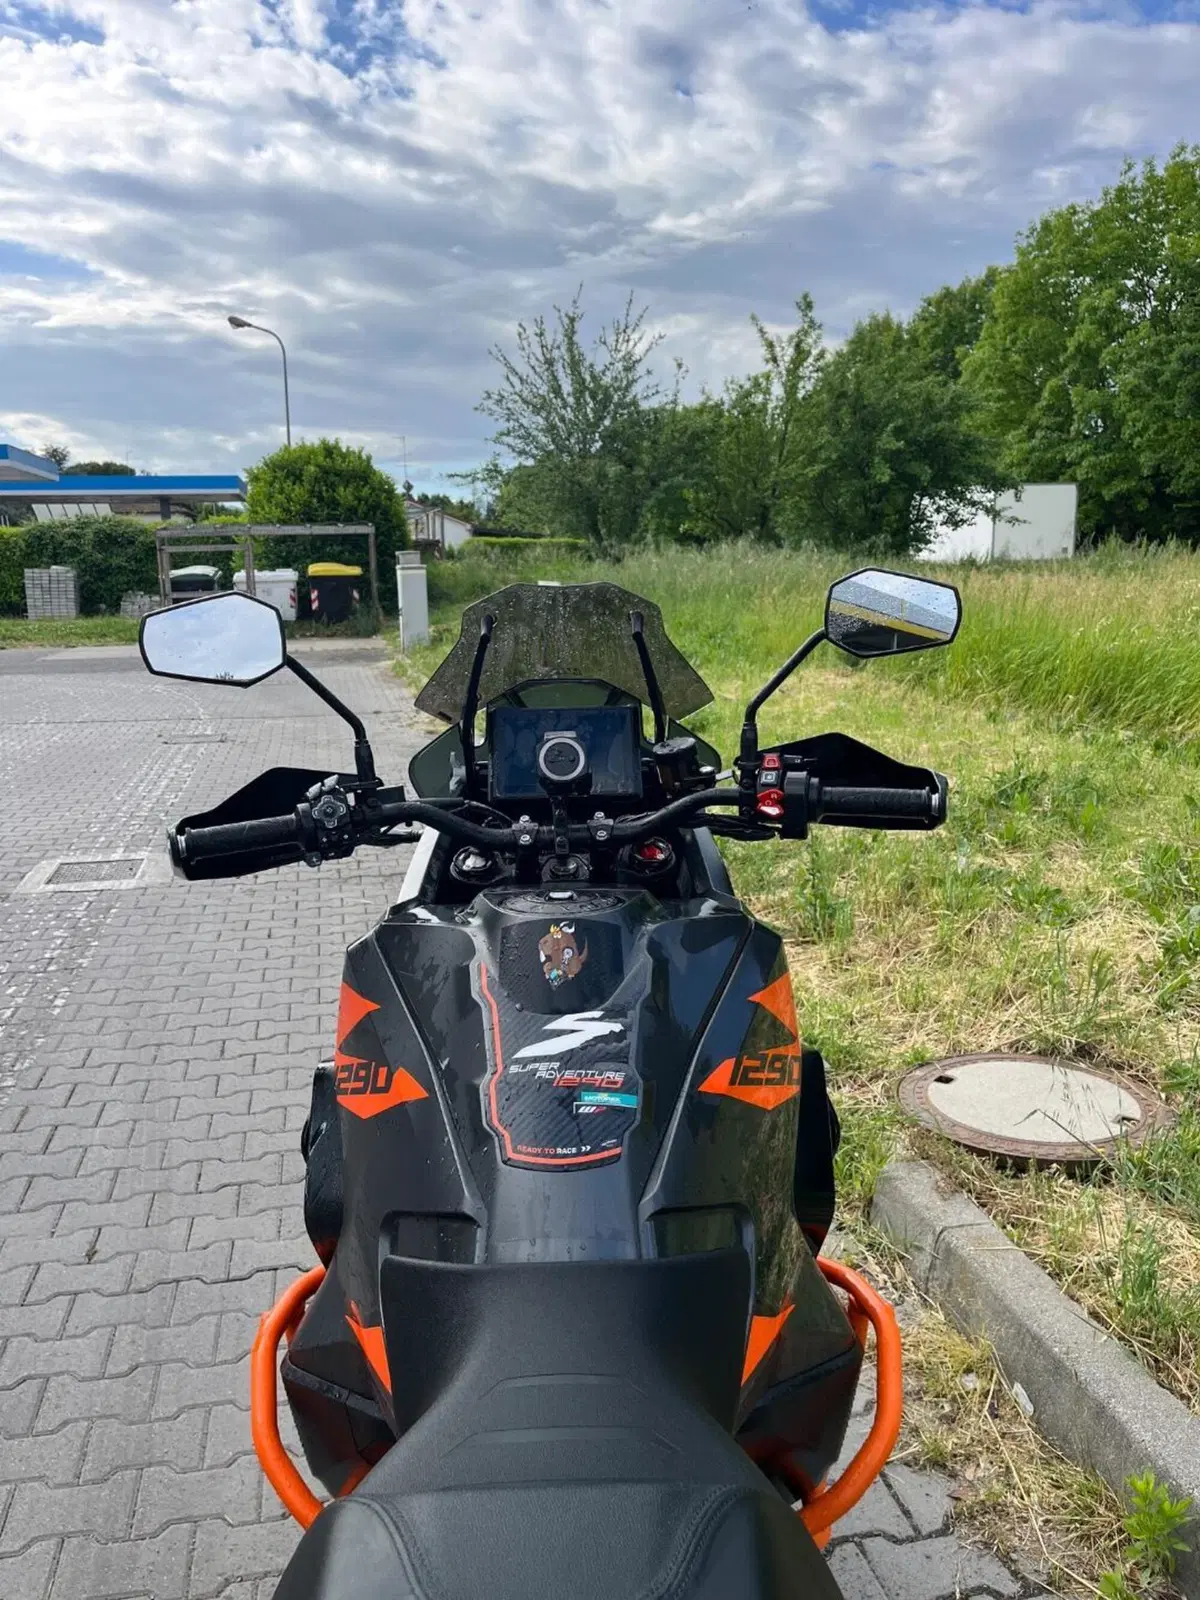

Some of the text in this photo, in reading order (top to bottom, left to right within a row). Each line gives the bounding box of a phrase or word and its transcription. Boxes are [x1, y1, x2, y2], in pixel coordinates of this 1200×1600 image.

[509, 1062, 560, 1074] SUPER
[729, 1053, 801, 1084] 1290
[335, 1062, 391, 1094] 290
[535, 1070, 626, 1080] ADVENTURE
[552, 1077, 624, 1088] 1290
[516, 1144, 543, 1154] READY
